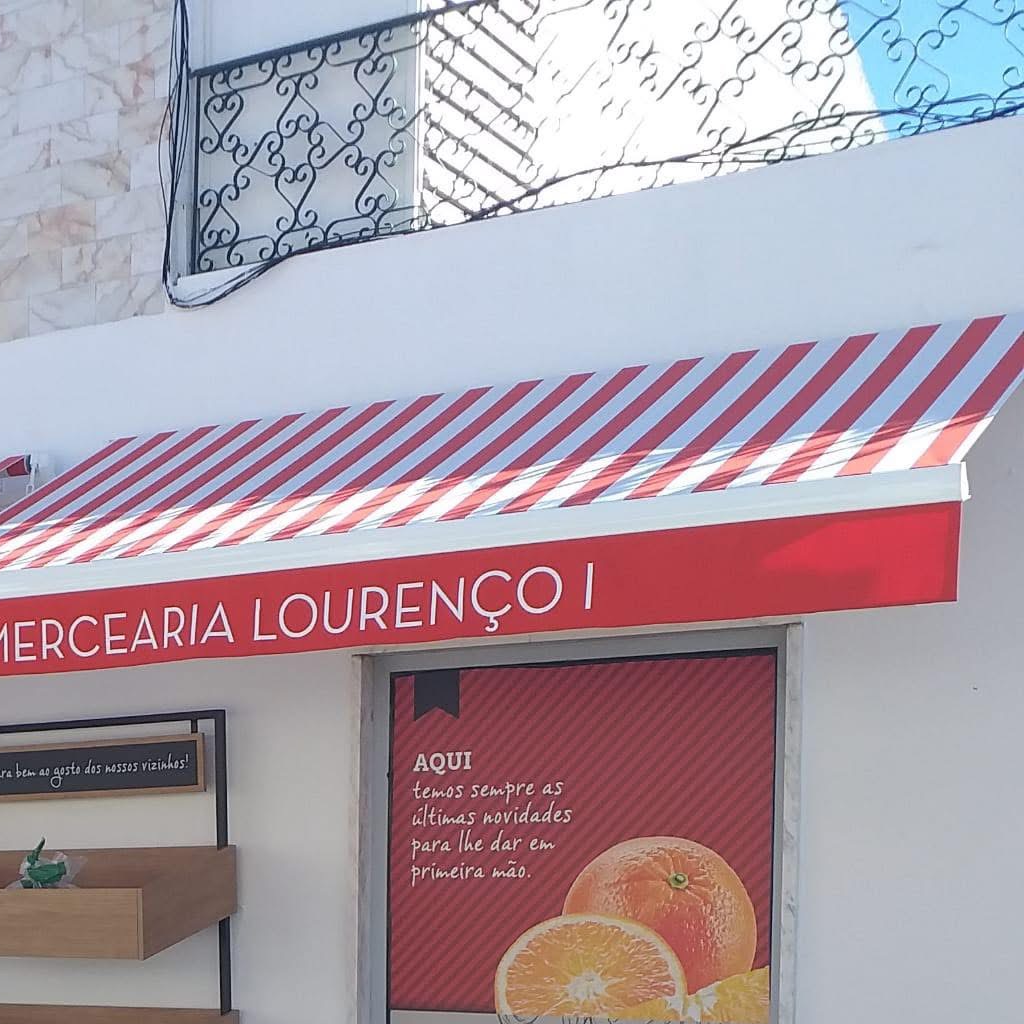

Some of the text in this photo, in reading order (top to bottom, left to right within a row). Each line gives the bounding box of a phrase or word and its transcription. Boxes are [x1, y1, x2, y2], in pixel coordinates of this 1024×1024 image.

[252, 565, 564, 642] LOURENÇO
[15, 762, 36, 779] bem
[38, 766, 51, 777] ao
[49, 762, 81, 789] gosto
[84, 759, 102, 775] dos
[105, 761, 138, 774] nossos
[141, 752, 189, 772] vizinhos!
[412, 751, 472, 775] AQUI
[412, 780, 564, 804] temos sempre as
[412, 800, 573, 827] últimas novidades
[411, 829, 555, 860] para lhe dar em
[411, 860, 532, 887] primeira mão.
